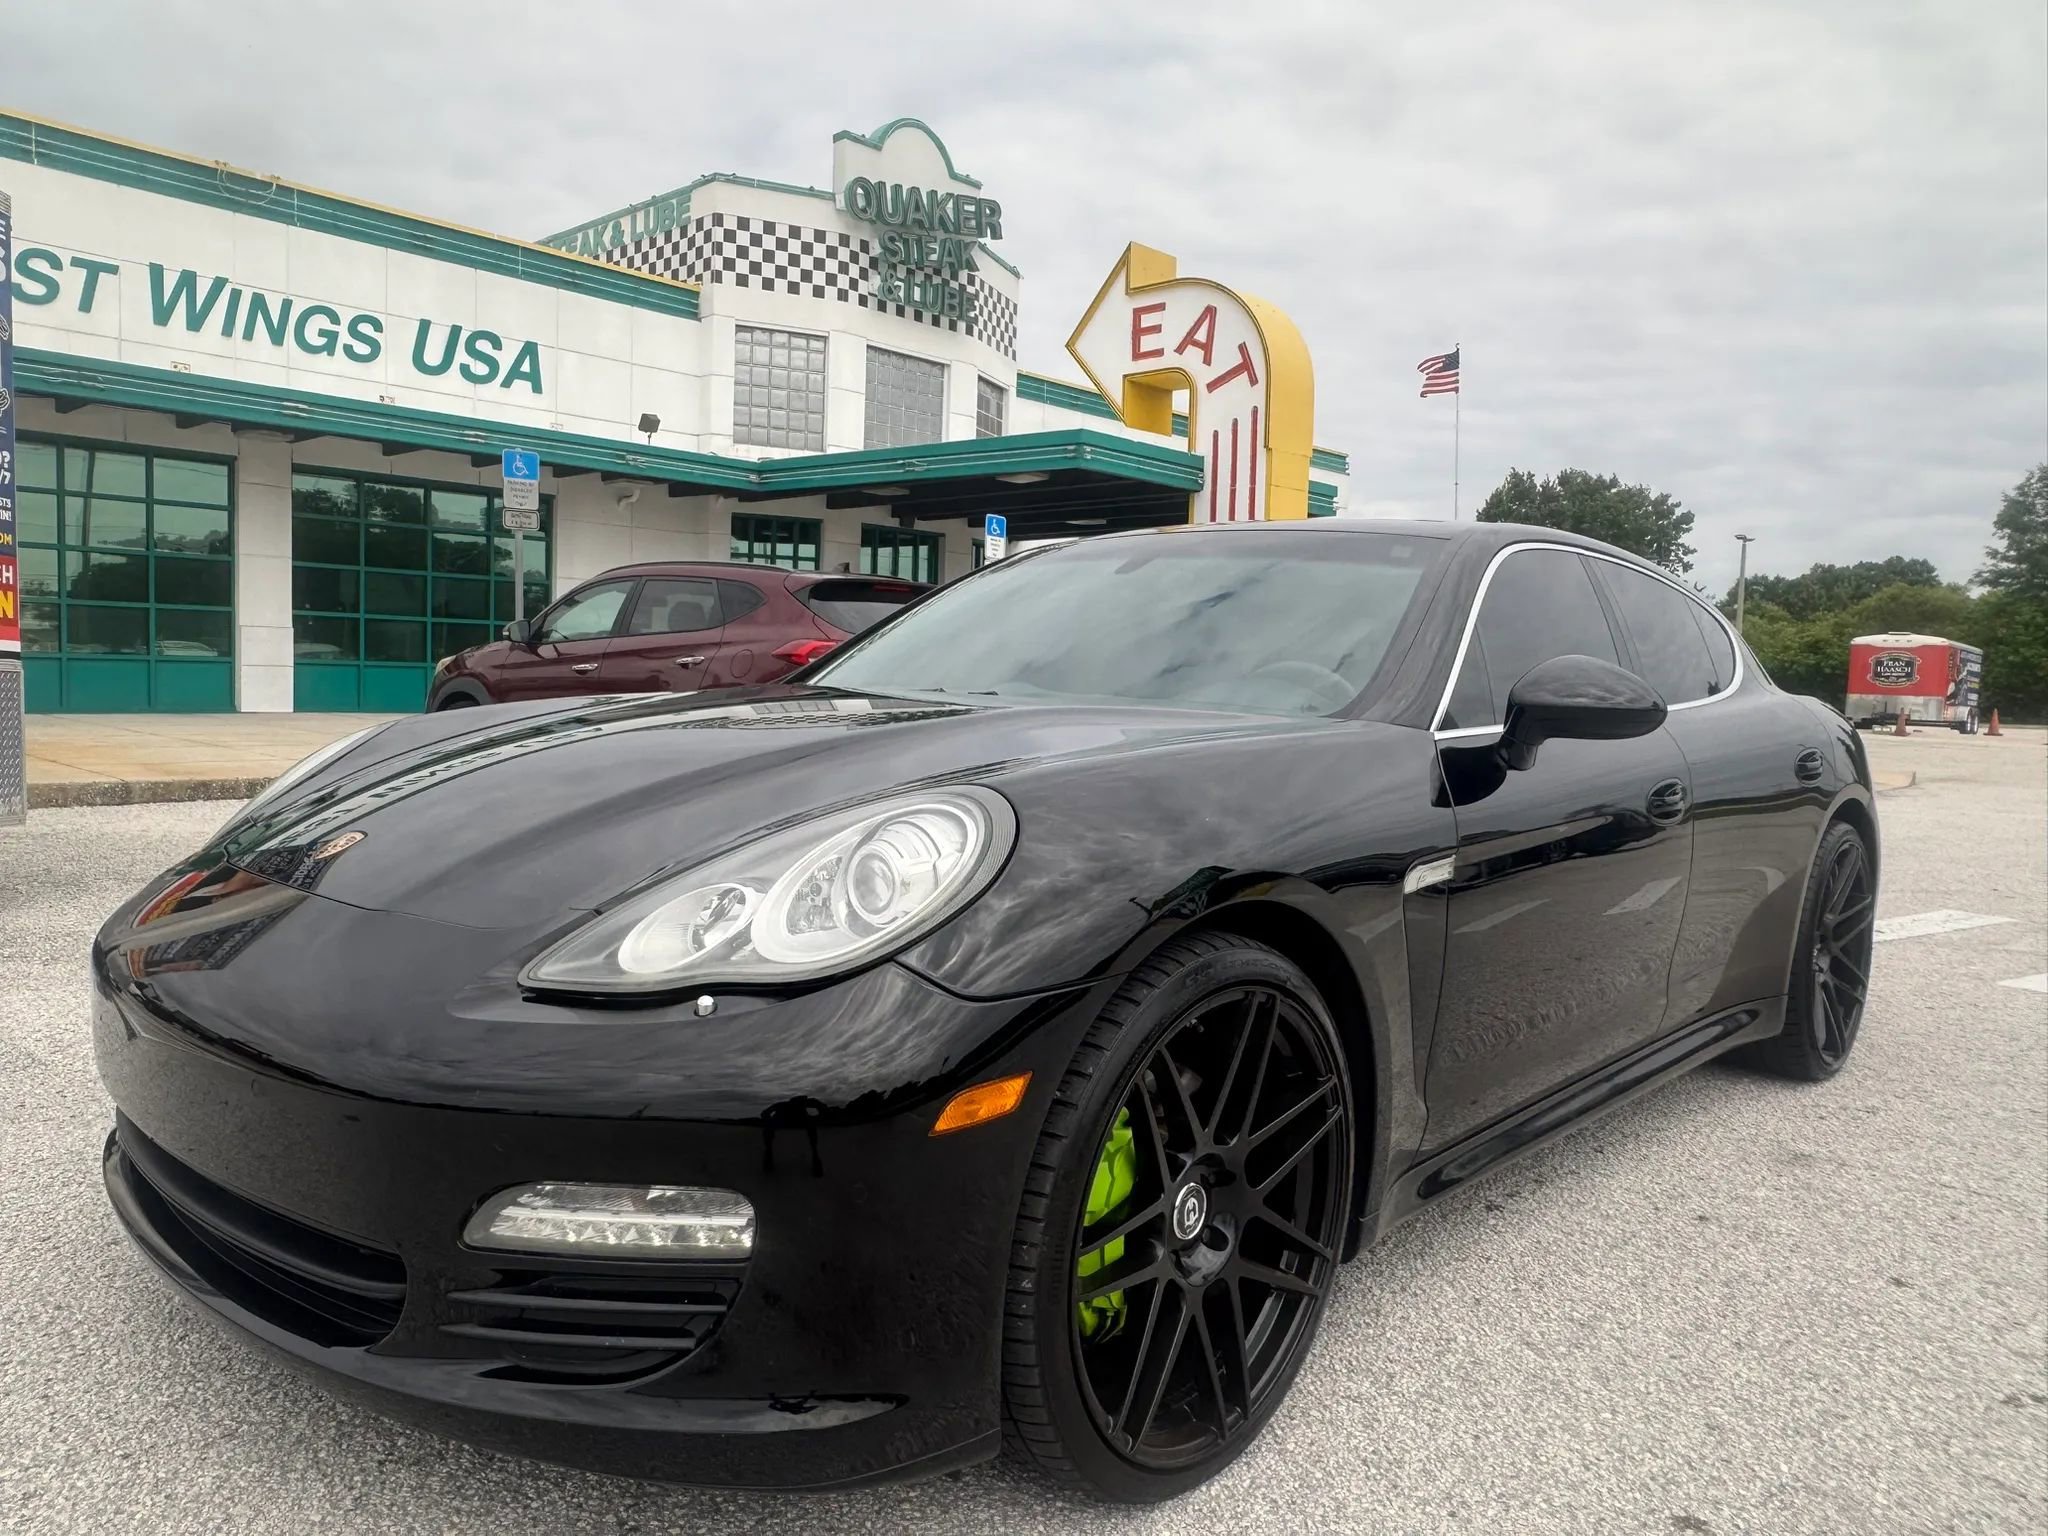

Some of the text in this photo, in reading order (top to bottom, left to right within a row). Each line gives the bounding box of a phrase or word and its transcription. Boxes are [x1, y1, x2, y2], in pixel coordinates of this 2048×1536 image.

[609, 219, 625, 249] &
[630, 194, 691, 242] LUBE
[844, 176, 1003, 240] QUAKER
[878, 229, 980, 273] STEAK
[149, 262, 384, 363] WINGS
[412, 318, 544, 394] USA
[904, 272, 979, 325] LUBE
[1131, 302, 1258, 393] EAT
